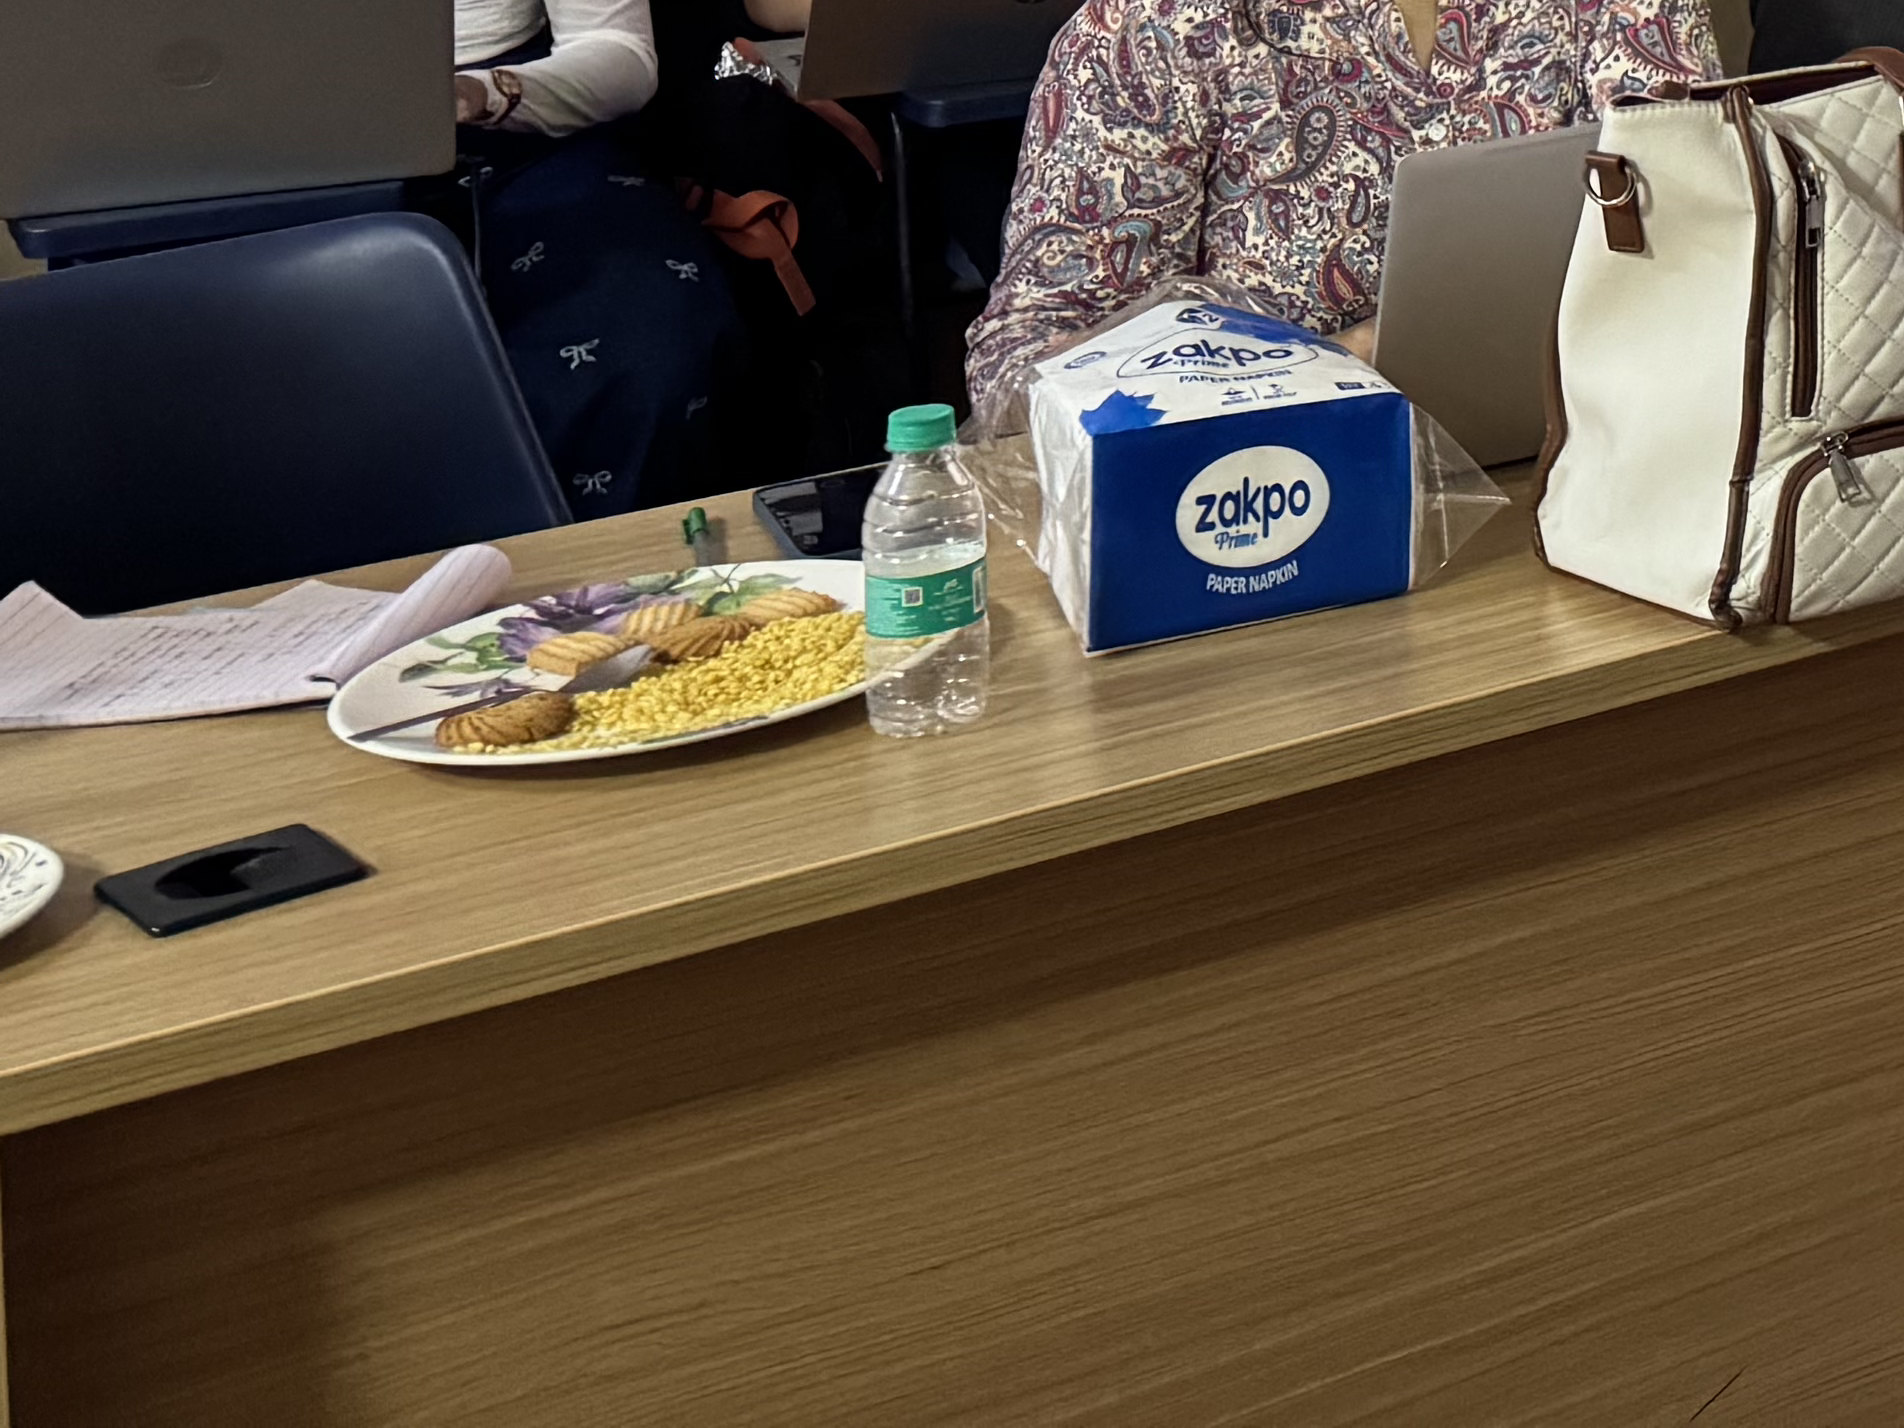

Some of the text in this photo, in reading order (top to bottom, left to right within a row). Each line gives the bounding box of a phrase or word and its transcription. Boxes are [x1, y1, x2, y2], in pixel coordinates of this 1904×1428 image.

[1140, 338, 1296, 371] zakpo
[1179, 368, 1294, 384] PAPER NAPKIN
[1195, 476, 1311, 539] zakpo
[1214, 529, 1259, 550] Prime
[1206, 560, 1299, 595] PAPER NAPKIN
